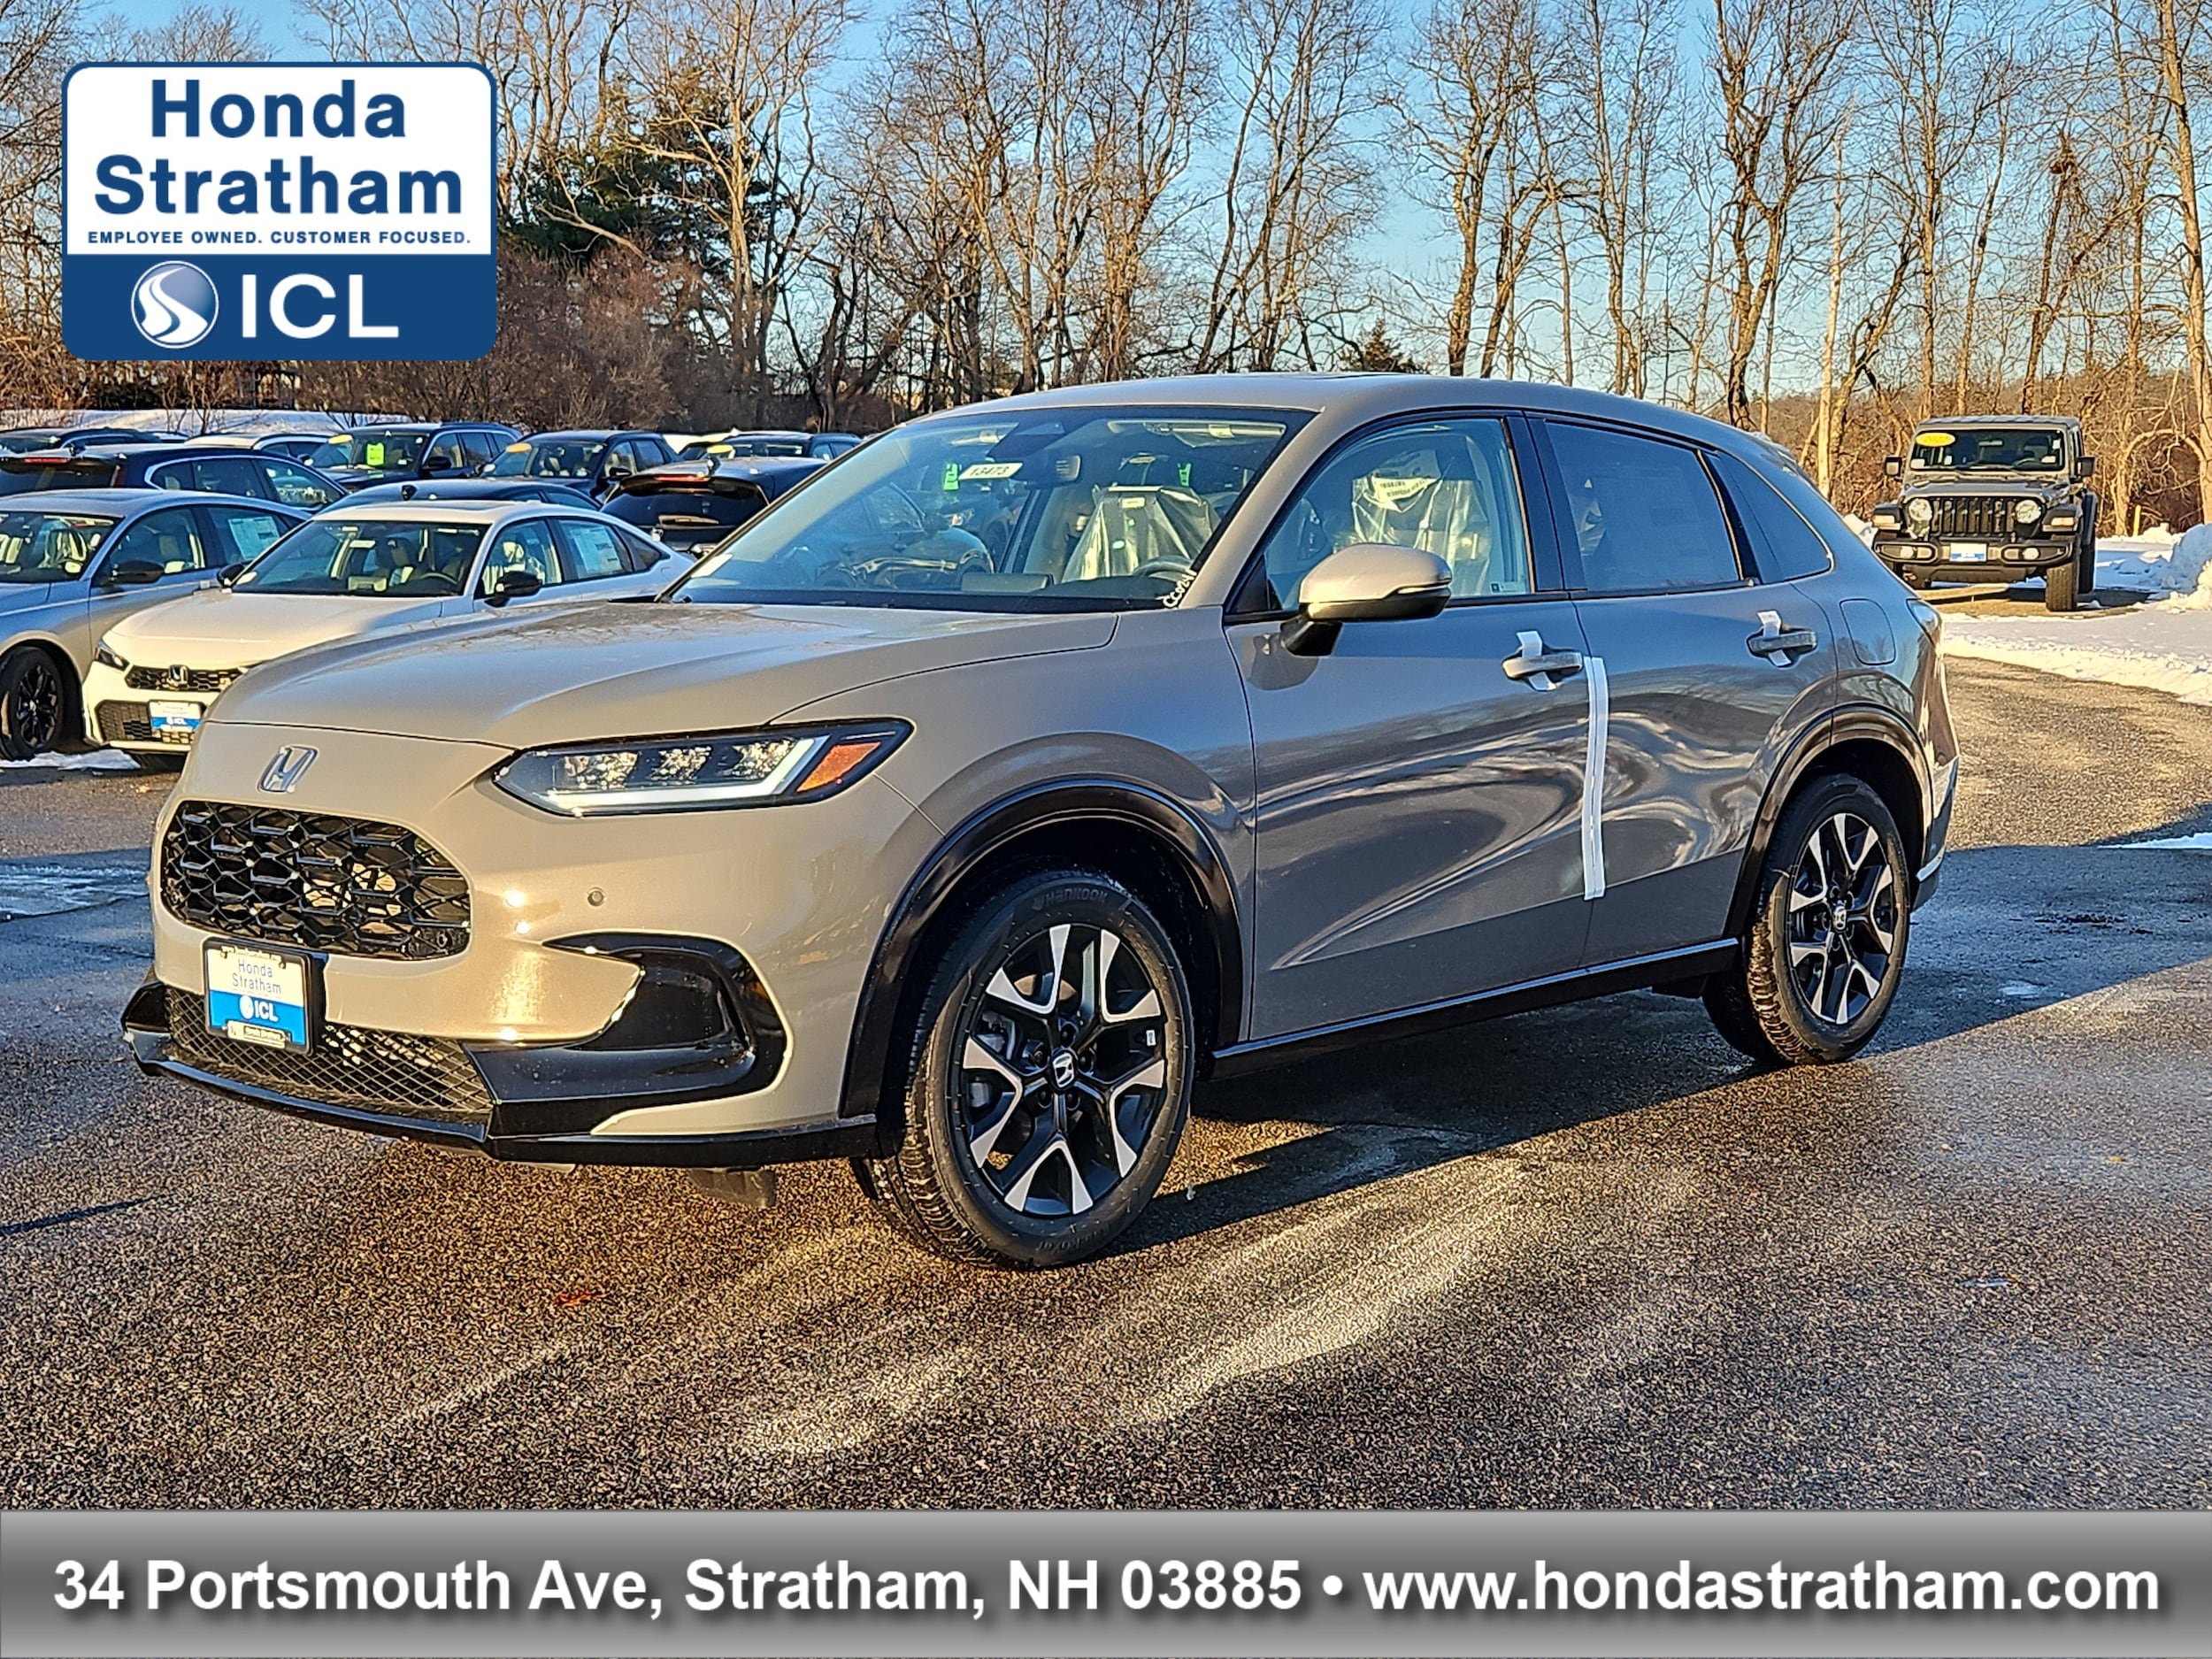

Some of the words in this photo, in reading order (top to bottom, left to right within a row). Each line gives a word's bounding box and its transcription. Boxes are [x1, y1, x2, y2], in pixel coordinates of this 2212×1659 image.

[238, 959, 273, 978] Honda
[232, 972, 281, 995] Stratham
[254, 1000, 279, 1022] ICL
